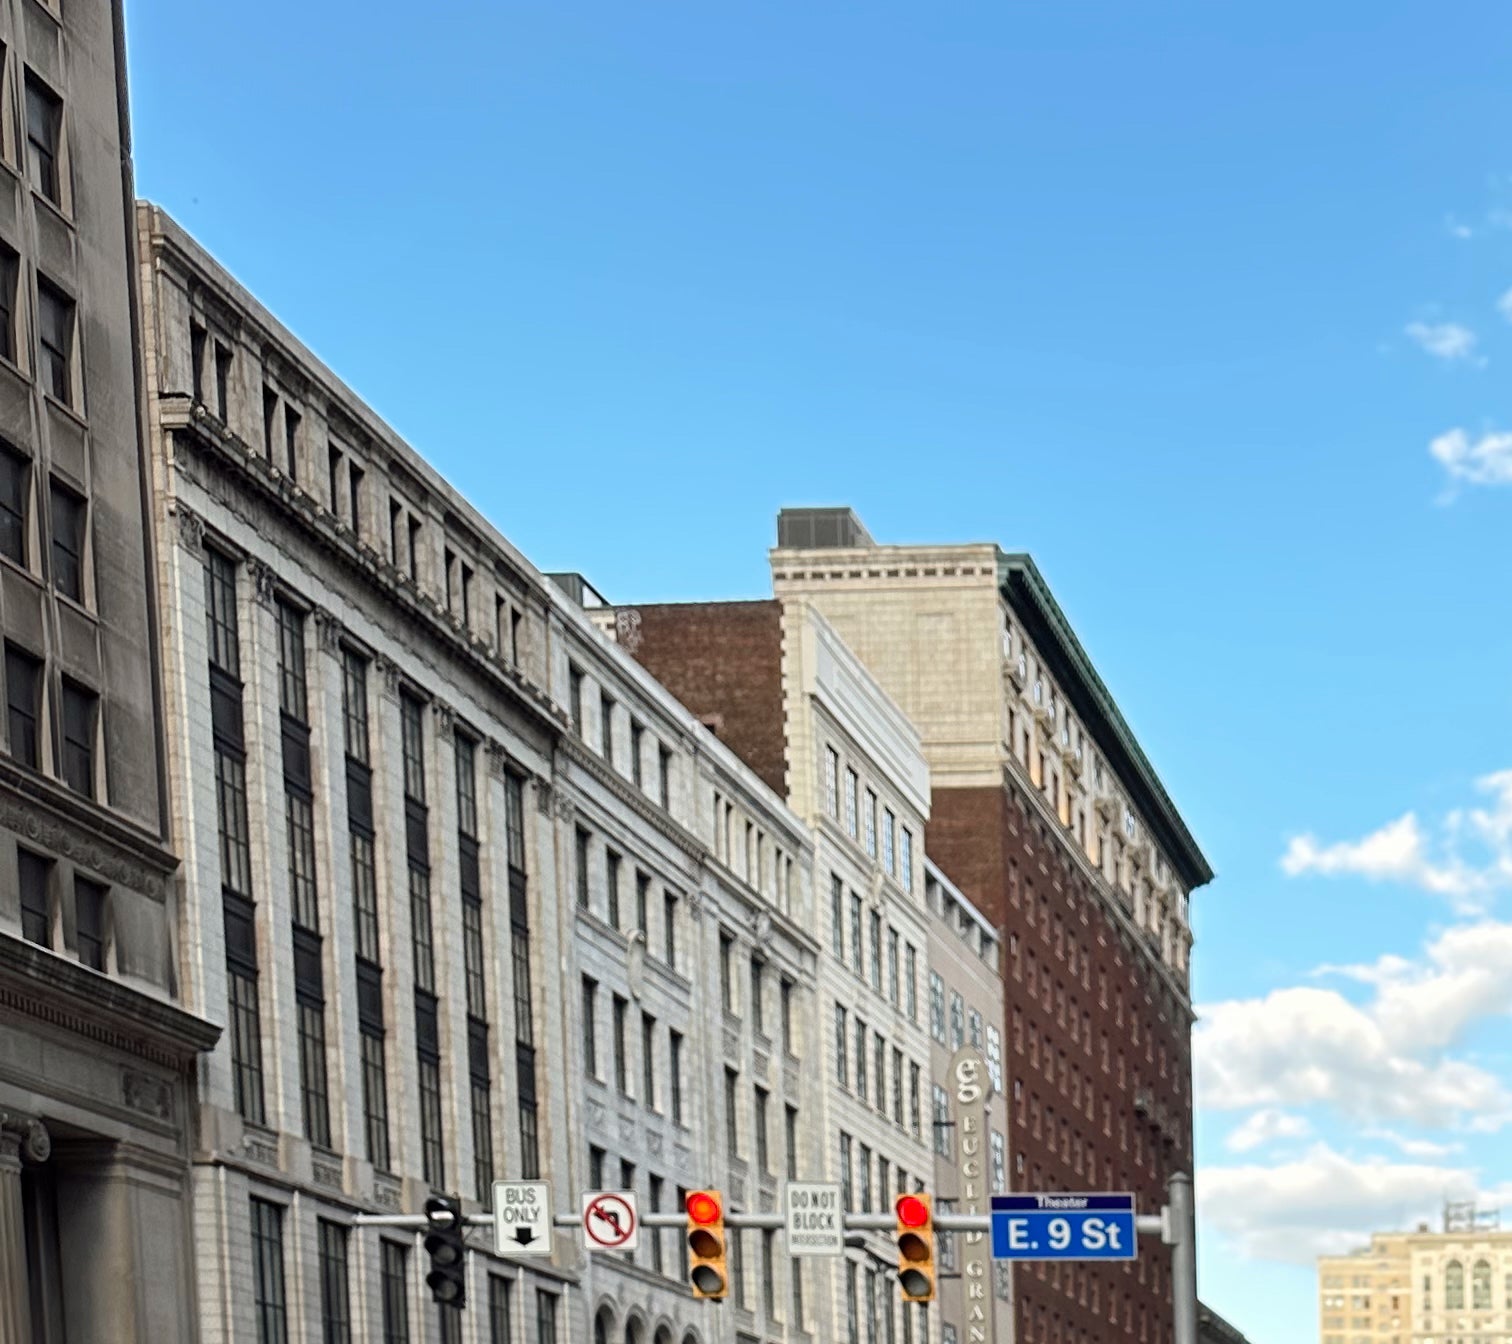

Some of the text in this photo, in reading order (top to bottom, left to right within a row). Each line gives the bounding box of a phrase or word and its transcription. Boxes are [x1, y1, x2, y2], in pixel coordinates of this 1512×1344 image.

[505, 1187, 536, 1204] BUS
[791, 1190, 836, 1209] DO NOT
[1035, 1194, 1088, 1209] Theater
[503, 1206, 540, 1224] ONLY
[793, 1212, 835, 1230] BLOCK
[1007, 1217, 1122, 1250] E. 9 St
